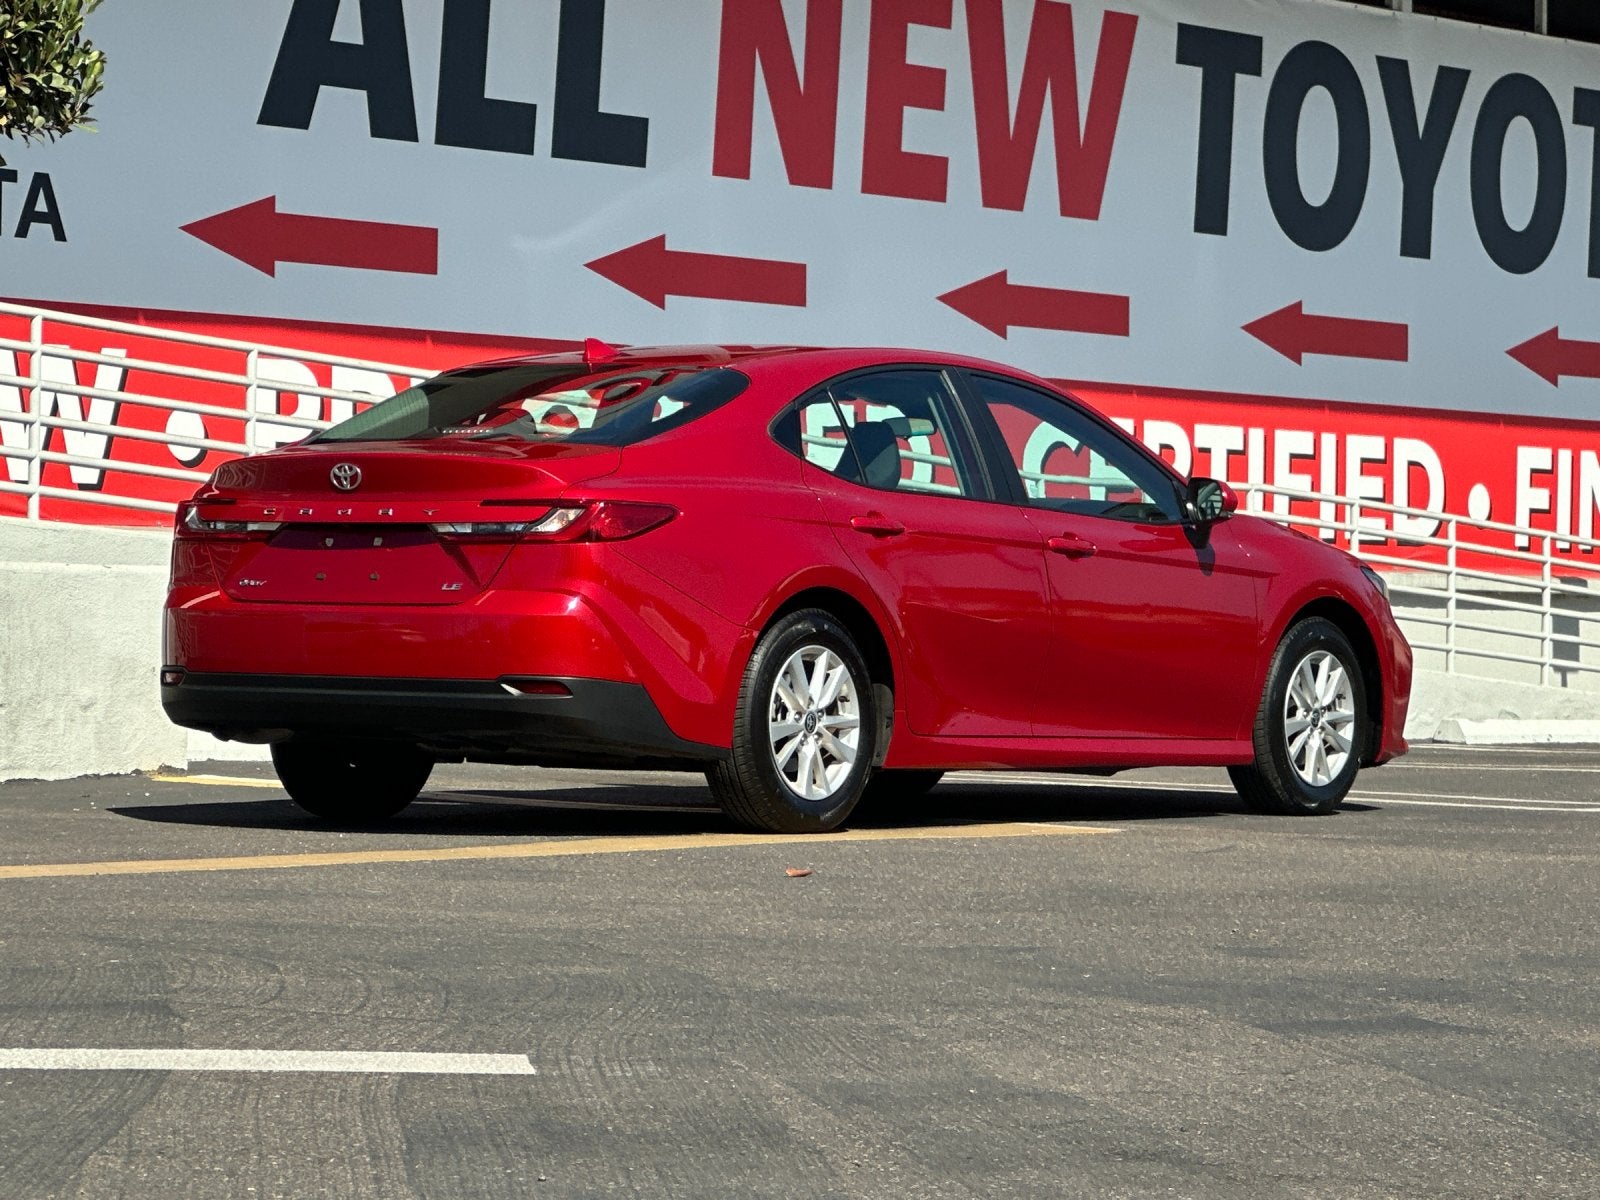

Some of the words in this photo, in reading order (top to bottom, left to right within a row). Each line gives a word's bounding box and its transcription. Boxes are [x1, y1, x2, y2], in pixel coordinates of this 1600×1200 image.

[257, 0, 649, 168] ALL
[712, 0, 1138, 221] NEW
[263, 507, 438, 517] CAMRY
[441, 583, 463, 591] LE
